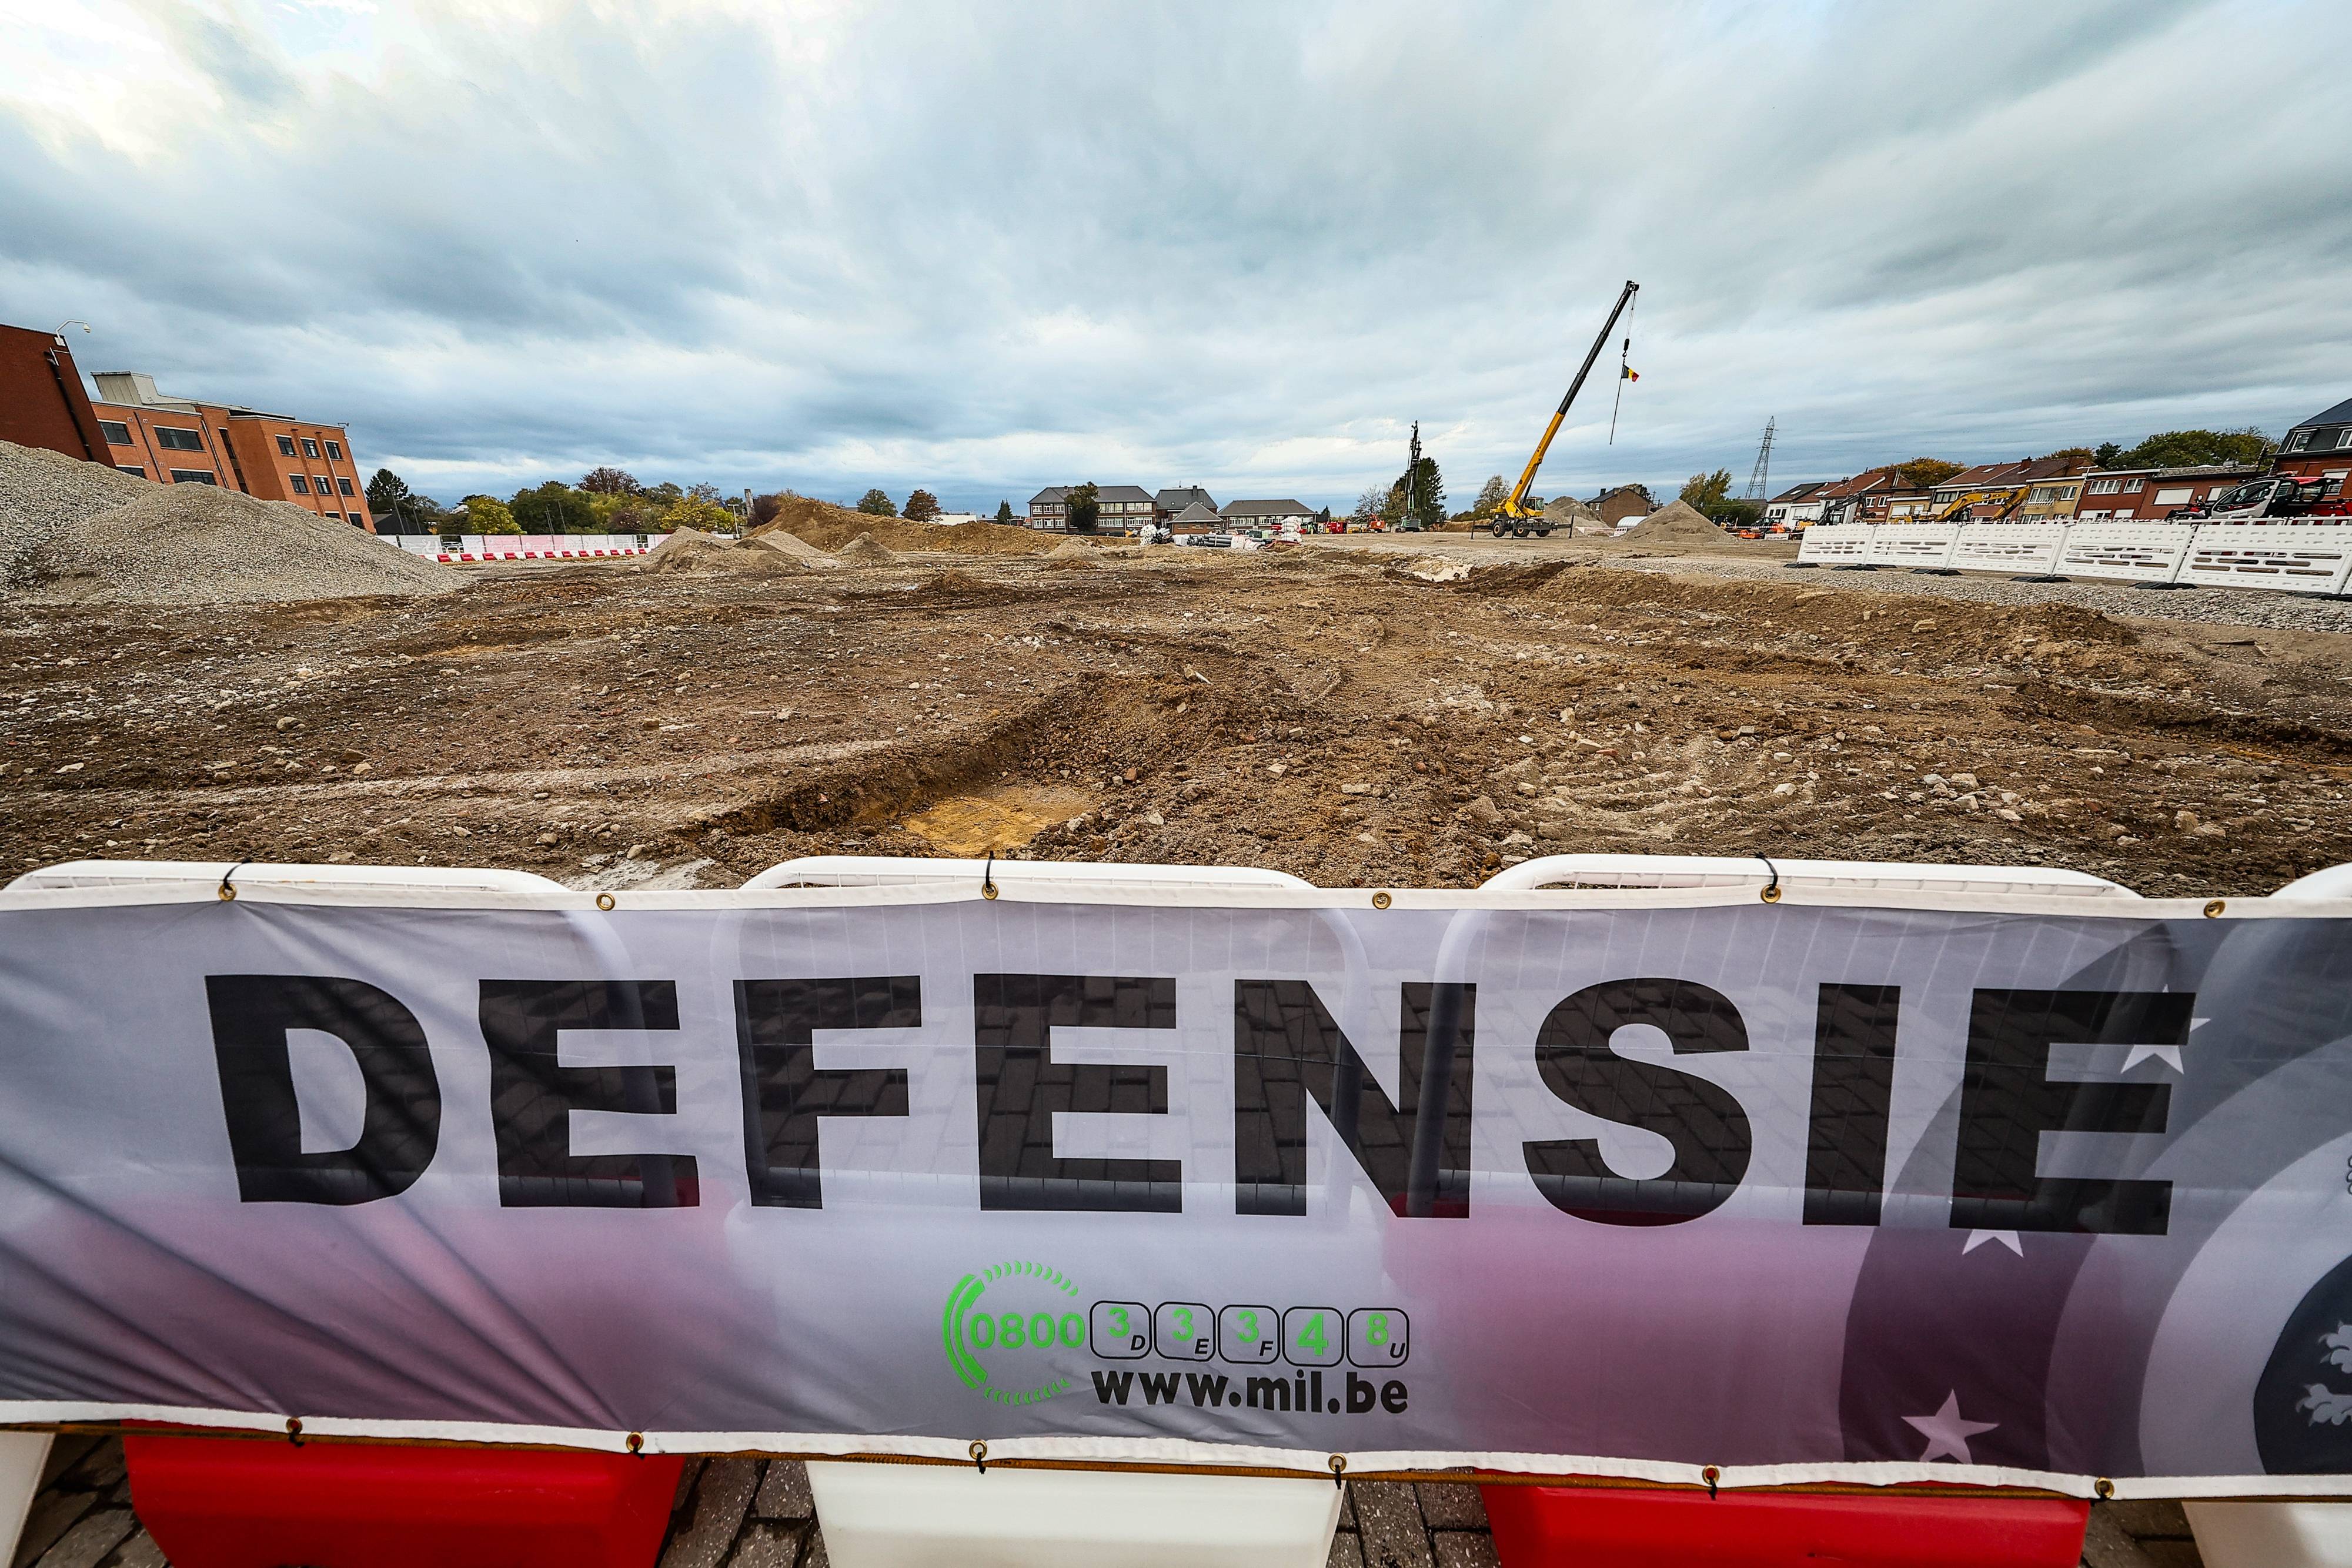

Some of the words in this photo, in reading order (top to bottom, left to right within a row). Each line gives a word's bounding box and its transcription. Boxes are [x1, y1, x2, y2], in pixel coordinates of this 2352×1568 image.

[205, 974, 2196, 1235] DEFENSIE
[970, 1312, 1085, 1349] 0800
[1091, 1369, 1408, 1414] www.mil.be
